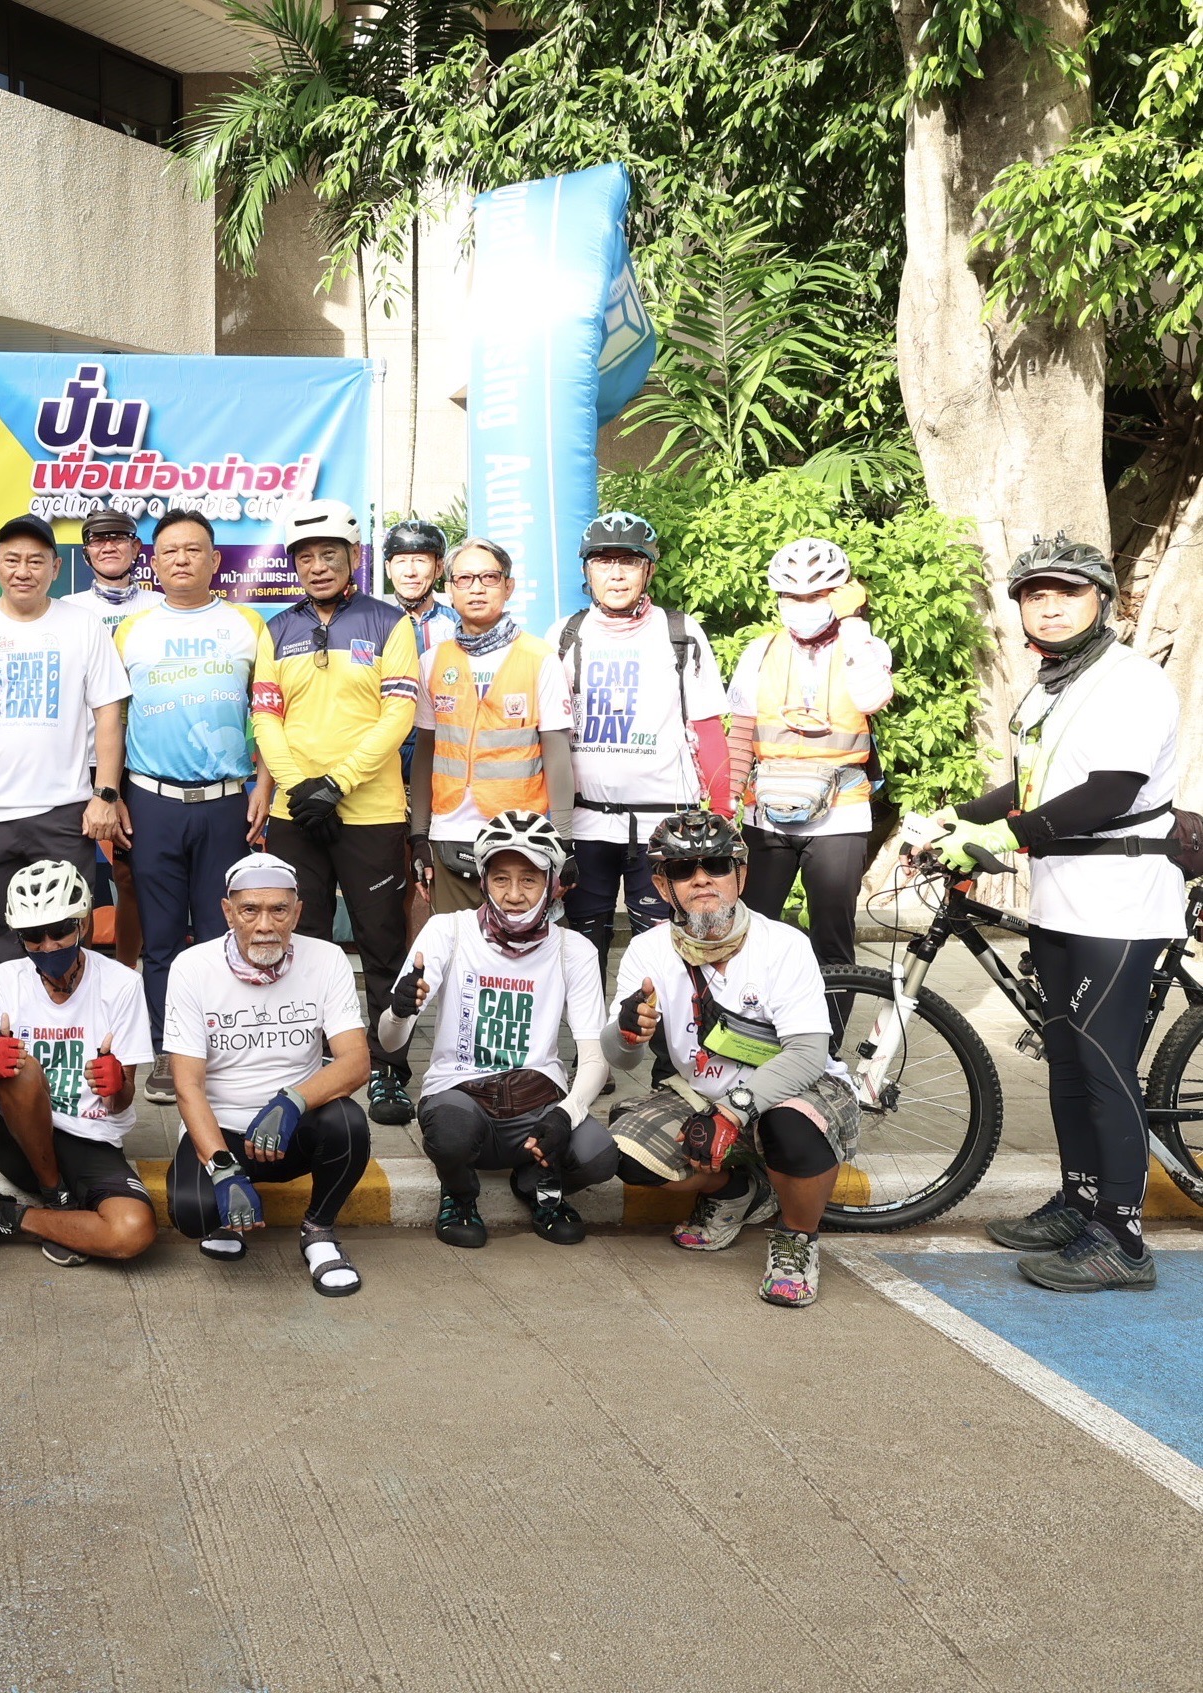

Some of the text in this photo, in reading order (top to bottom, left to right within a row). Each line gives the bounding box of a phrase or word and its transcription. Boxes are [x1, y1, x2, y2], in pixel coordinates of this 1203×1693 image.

[37, 366, 142, 448] ปั่น
[31, 496, 99, 515] cycling
[112, 496, 139, 513] for
[149, 503, 160, 513] a
[7, 652, 44, 661] THAILAND
[6, 660, 44, 681] CAR
[148, 660, 234, 686] Bicycle Club
[586, 660, 640, 688] CAR
[6, 679, 43, 700] FREE
[5, 698, 43, 719] DAY
[142, 700, 176, 718] Share
[180, 693, 206, 707] The
[583, 716, 657, 746] DAY 2023
[479, 975, 535, 993] BANGKOK
[477, 988, 534, 1023] CAR
[33, 1026, 85, 1040] BANGKOK
[209, 1028, 316, 1051] BROMPTON
[474, 1016, 531, 1053] FREE
[33, 1040, 85, 1069] CAR
[473, 1044, 528, 1071] DAY
[45, 1068, 83, 1099] REE
